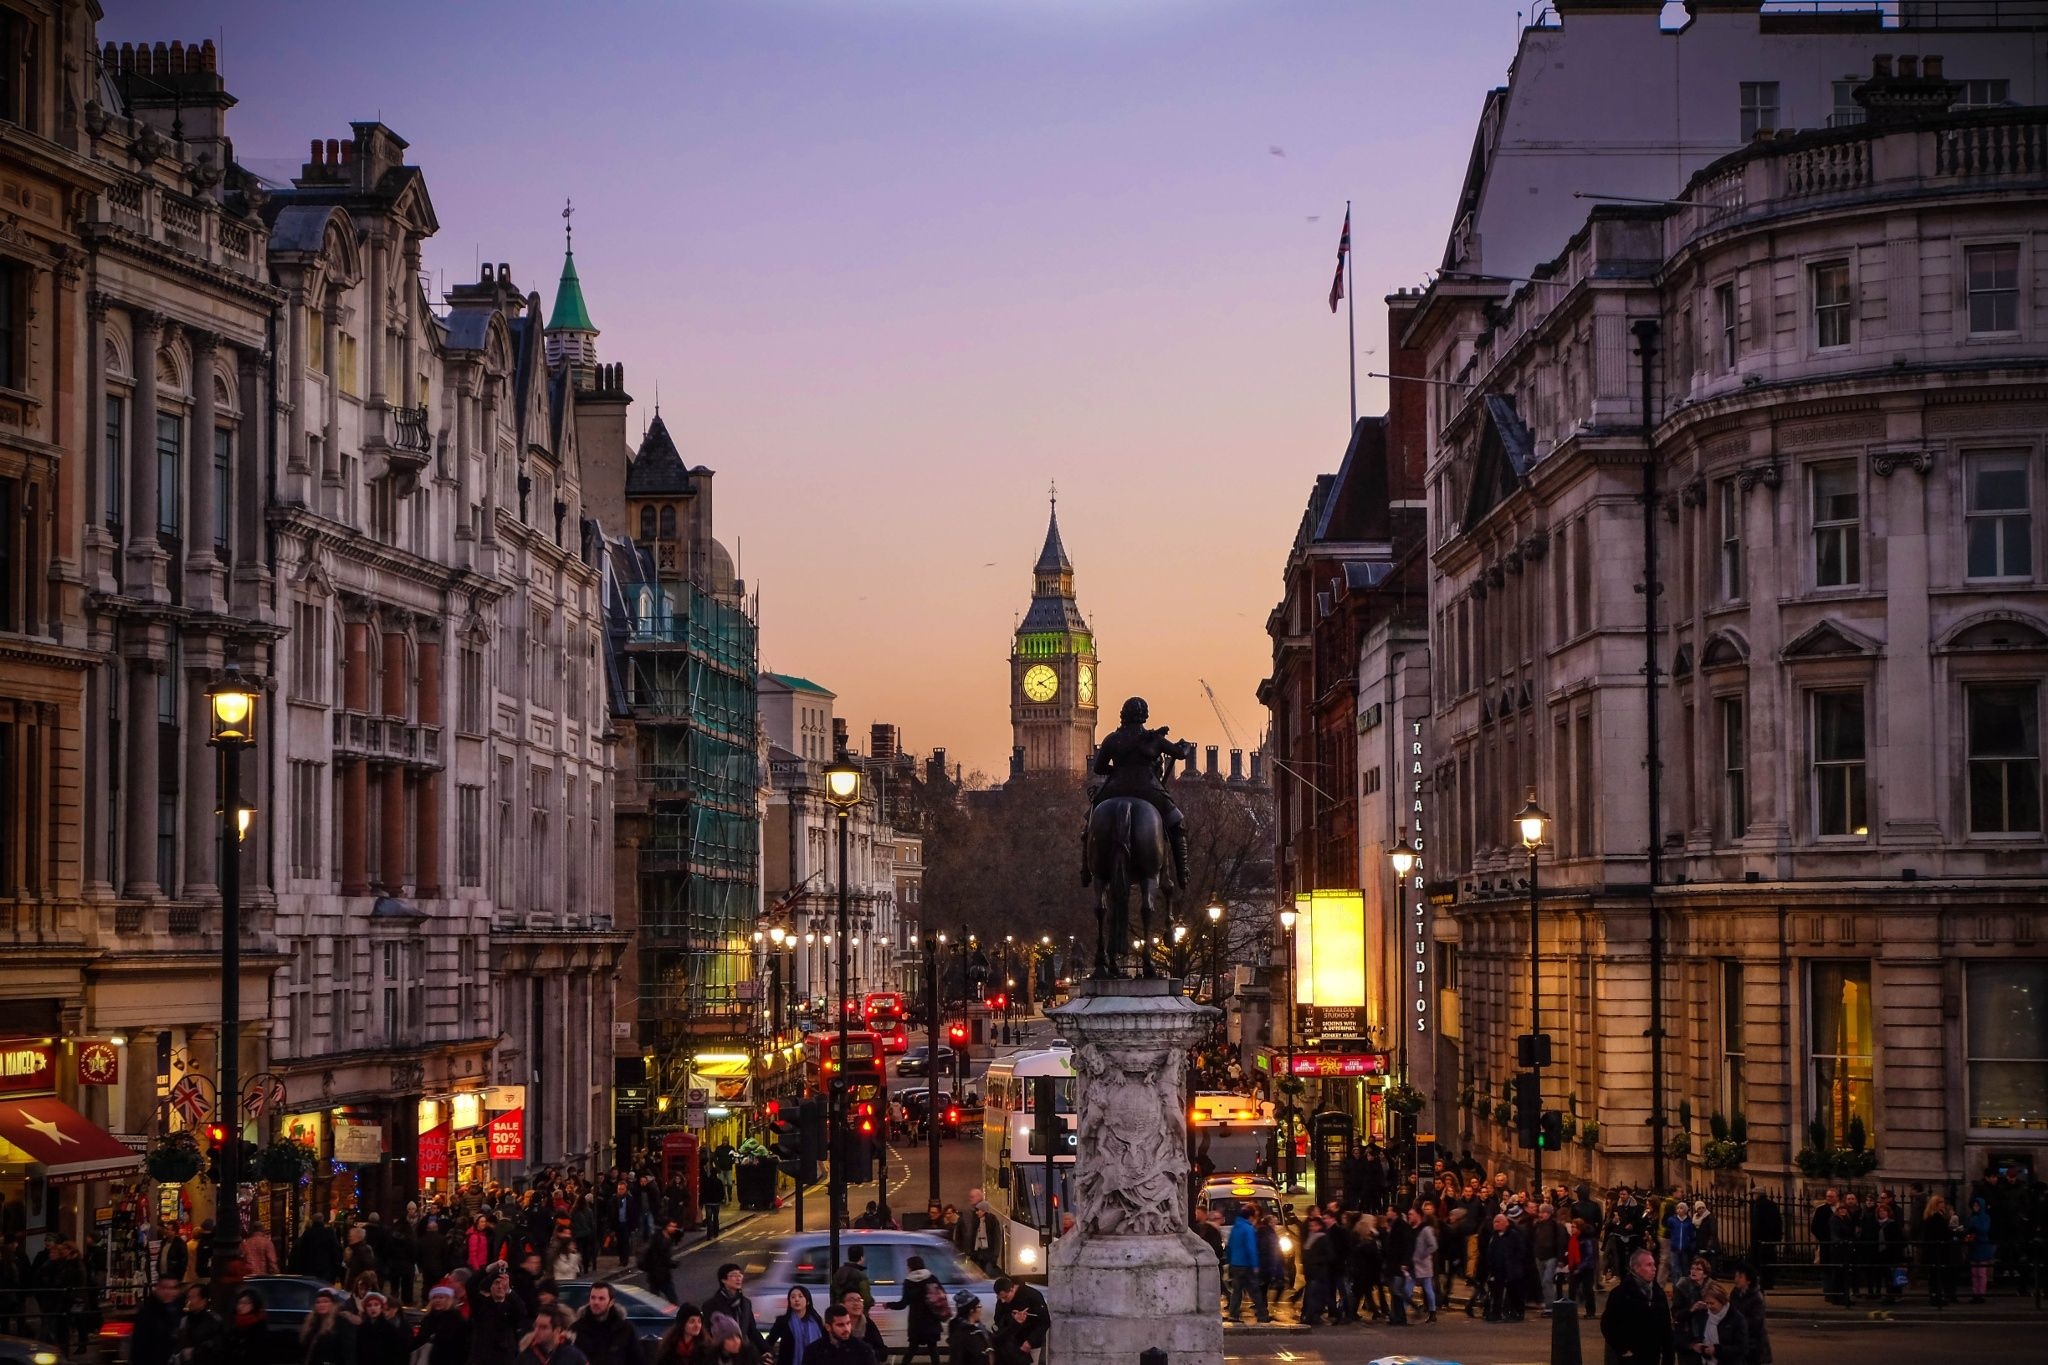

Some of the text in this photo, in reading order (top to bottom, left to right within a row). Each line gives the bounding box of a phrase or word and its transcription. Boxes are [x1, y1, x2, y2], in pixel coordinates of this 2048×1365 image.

[1413, 723, 1425, 1031] TRAFALGAR STUDIOS
[5, 1051, 35, 1076] MANGER
[493, 1122, 519, 1131] SALE
[419, 1137, 446, 1146] SALE
[492, 1133, 521, 1144] 50%
[418, 1149, 447, 1160] 50%
[495, 1145, 517, 1154] OFF
[422, 1163, 442, 1172] OFF
